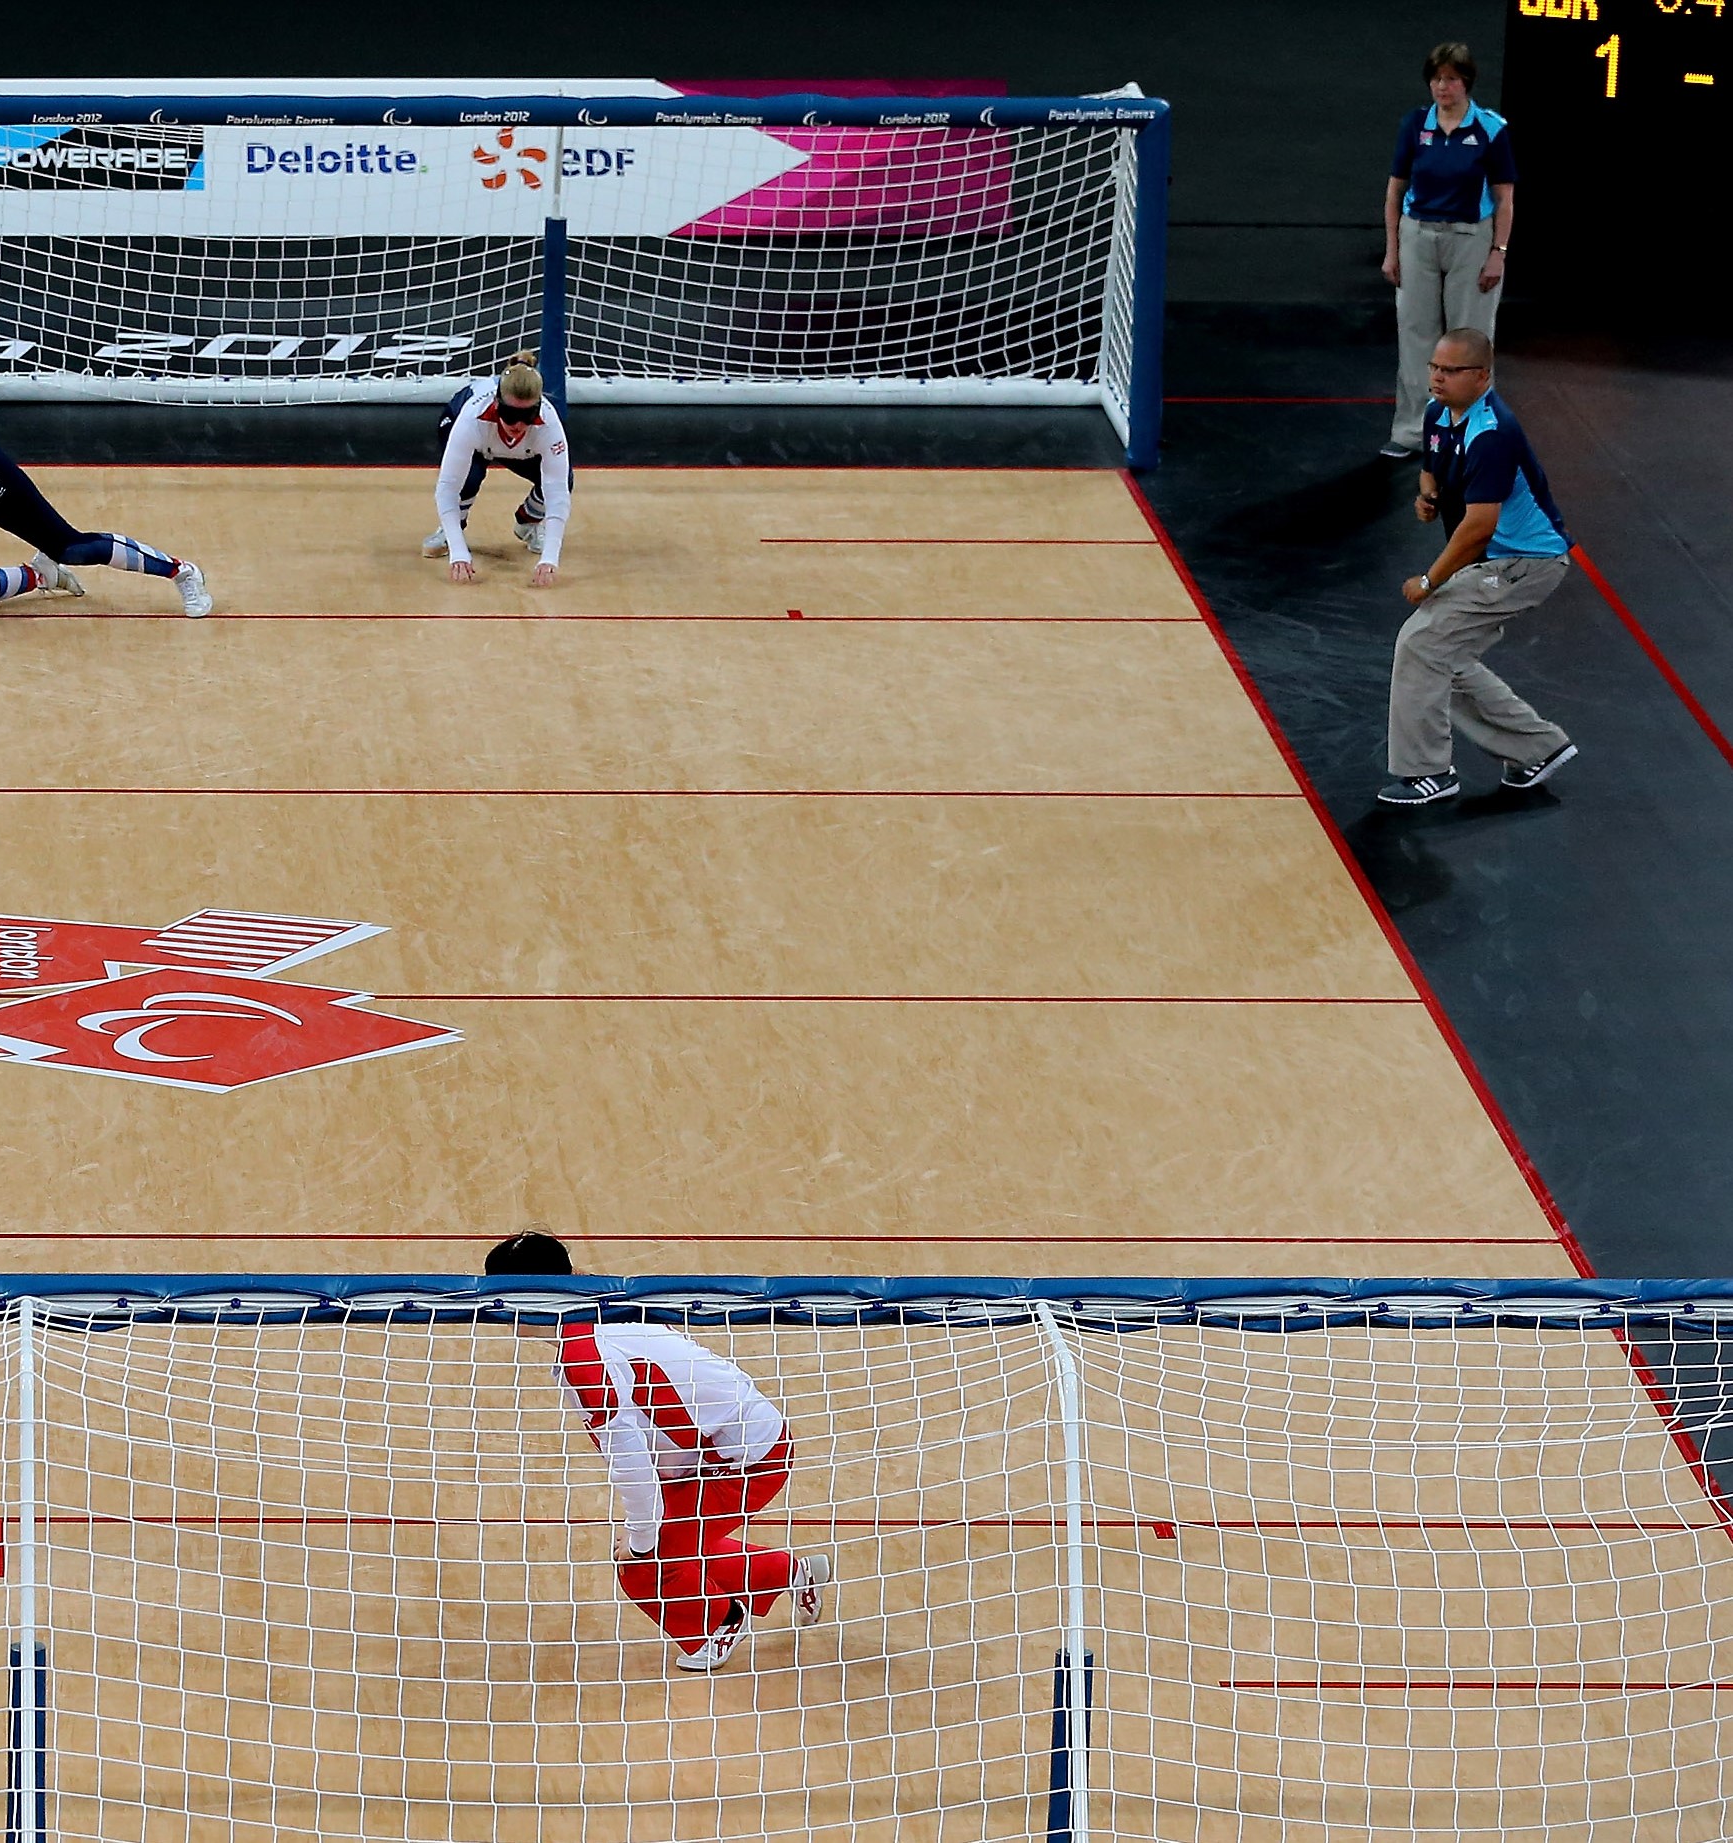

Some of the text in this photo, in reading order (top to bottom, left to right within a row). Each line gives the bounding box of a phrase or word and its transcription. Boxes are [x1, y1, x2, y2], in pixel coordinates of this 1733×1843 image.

[1595, 34, 1619, 97] 1
[32, 114, 102, 123] London 2012
[459, 112, 530, 123] London 2012
[655, 111, 763, 124] Paralympic Games
[879, 112, 950, 125] London 2012
[1048, 107, 1155, 122] Paralympic Games
[96, 332, 472, 361] 2012
